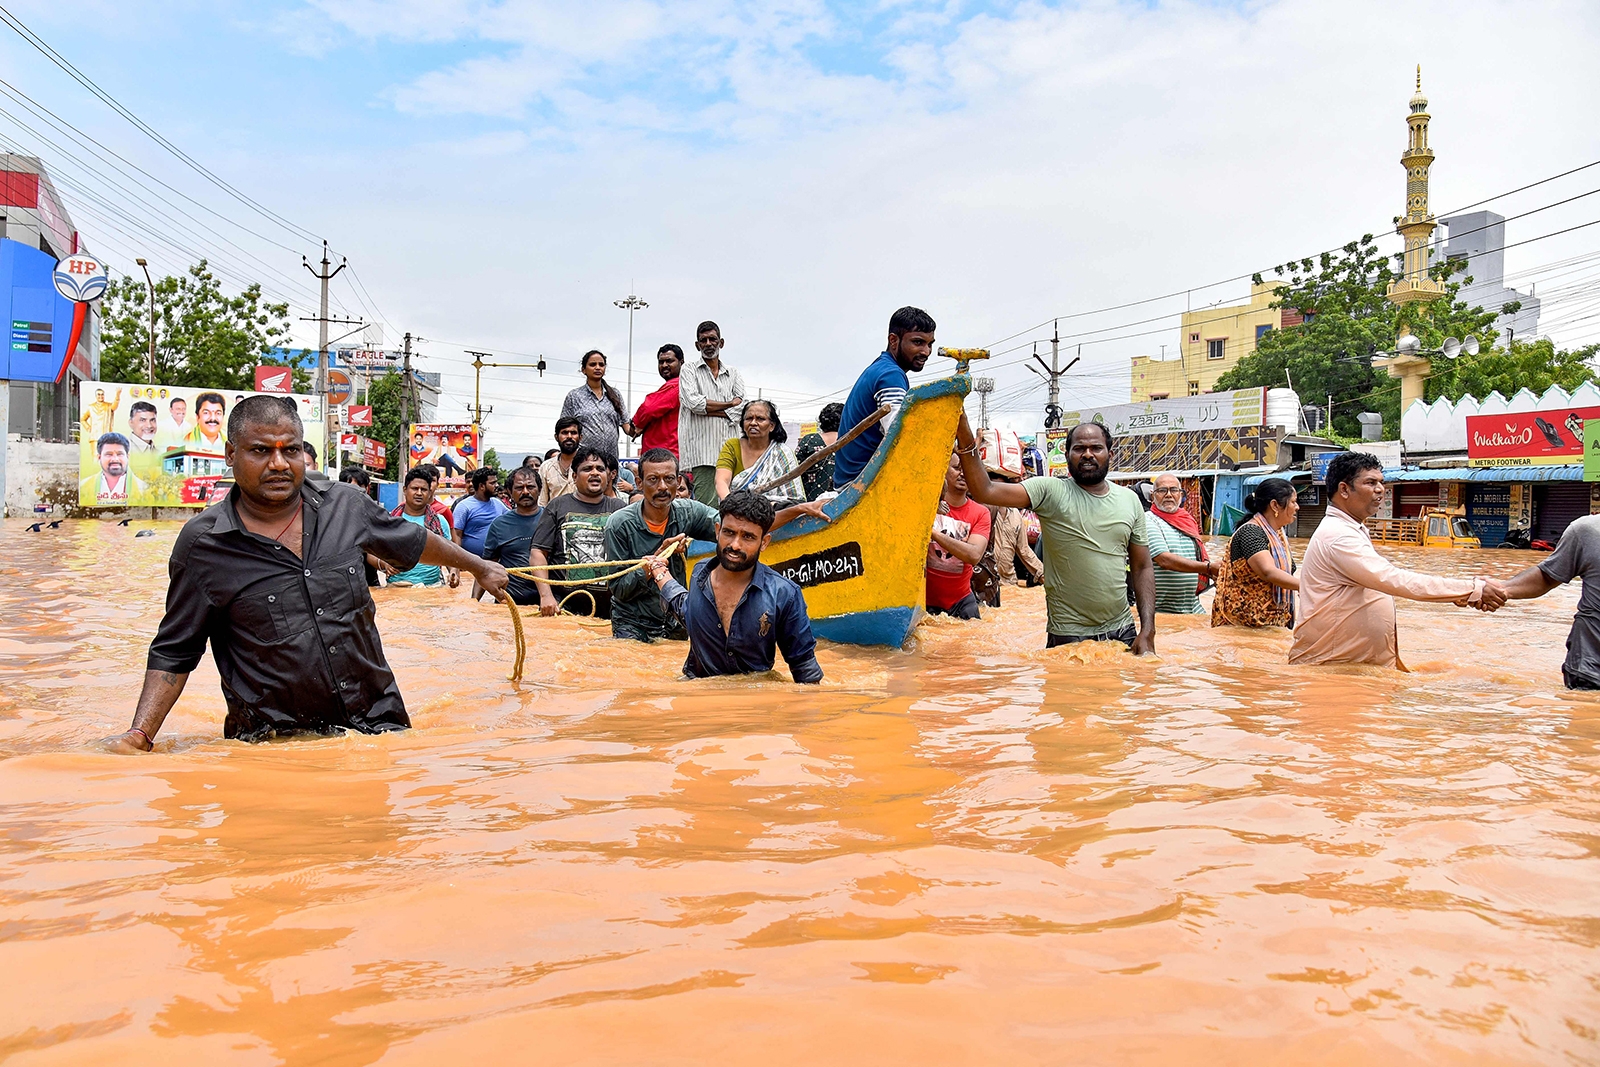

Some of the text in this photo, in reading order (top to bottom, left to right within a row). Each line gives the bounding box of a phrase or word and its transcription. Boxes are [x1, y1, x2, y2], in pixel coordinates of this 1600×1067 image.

[69, 260, 97, 275] HP
[355, 351, 385, 360] EAGLE
[1129, 413, 1169, 428] zaara
[1483, 494, 1510, 503] MOBILES
